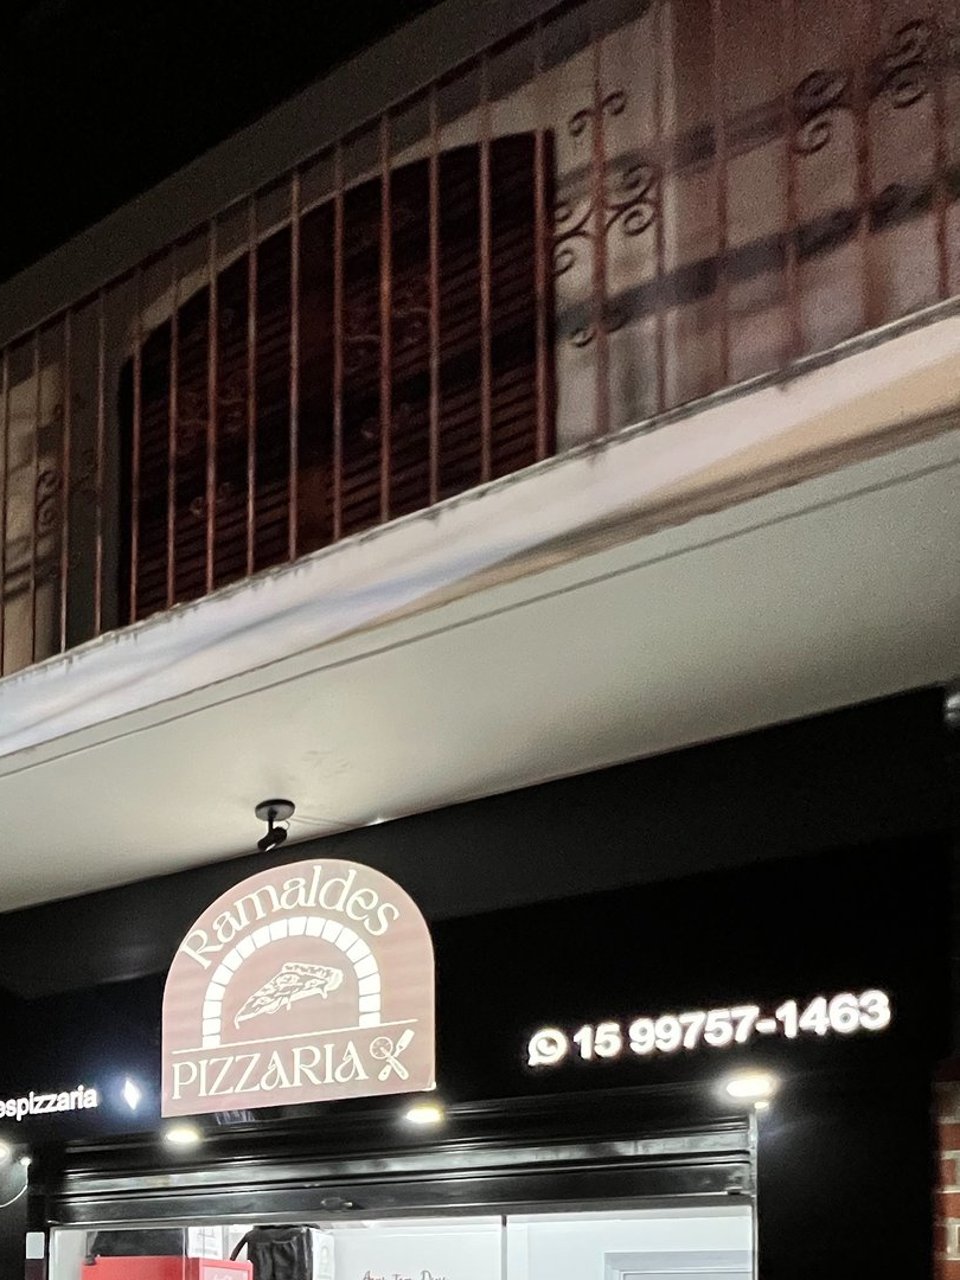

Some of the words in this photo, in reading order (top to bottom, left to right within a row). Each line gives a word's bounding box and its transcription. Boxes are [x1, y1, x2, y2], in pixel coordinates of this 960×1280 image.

[180, 865, 400, 970] Ramaldes
[573, 1021, 622, 1060] 15
[629, 990, 891, 1056] 99757-1463
[171, 1040, 369, 1100] PIZZARIA
